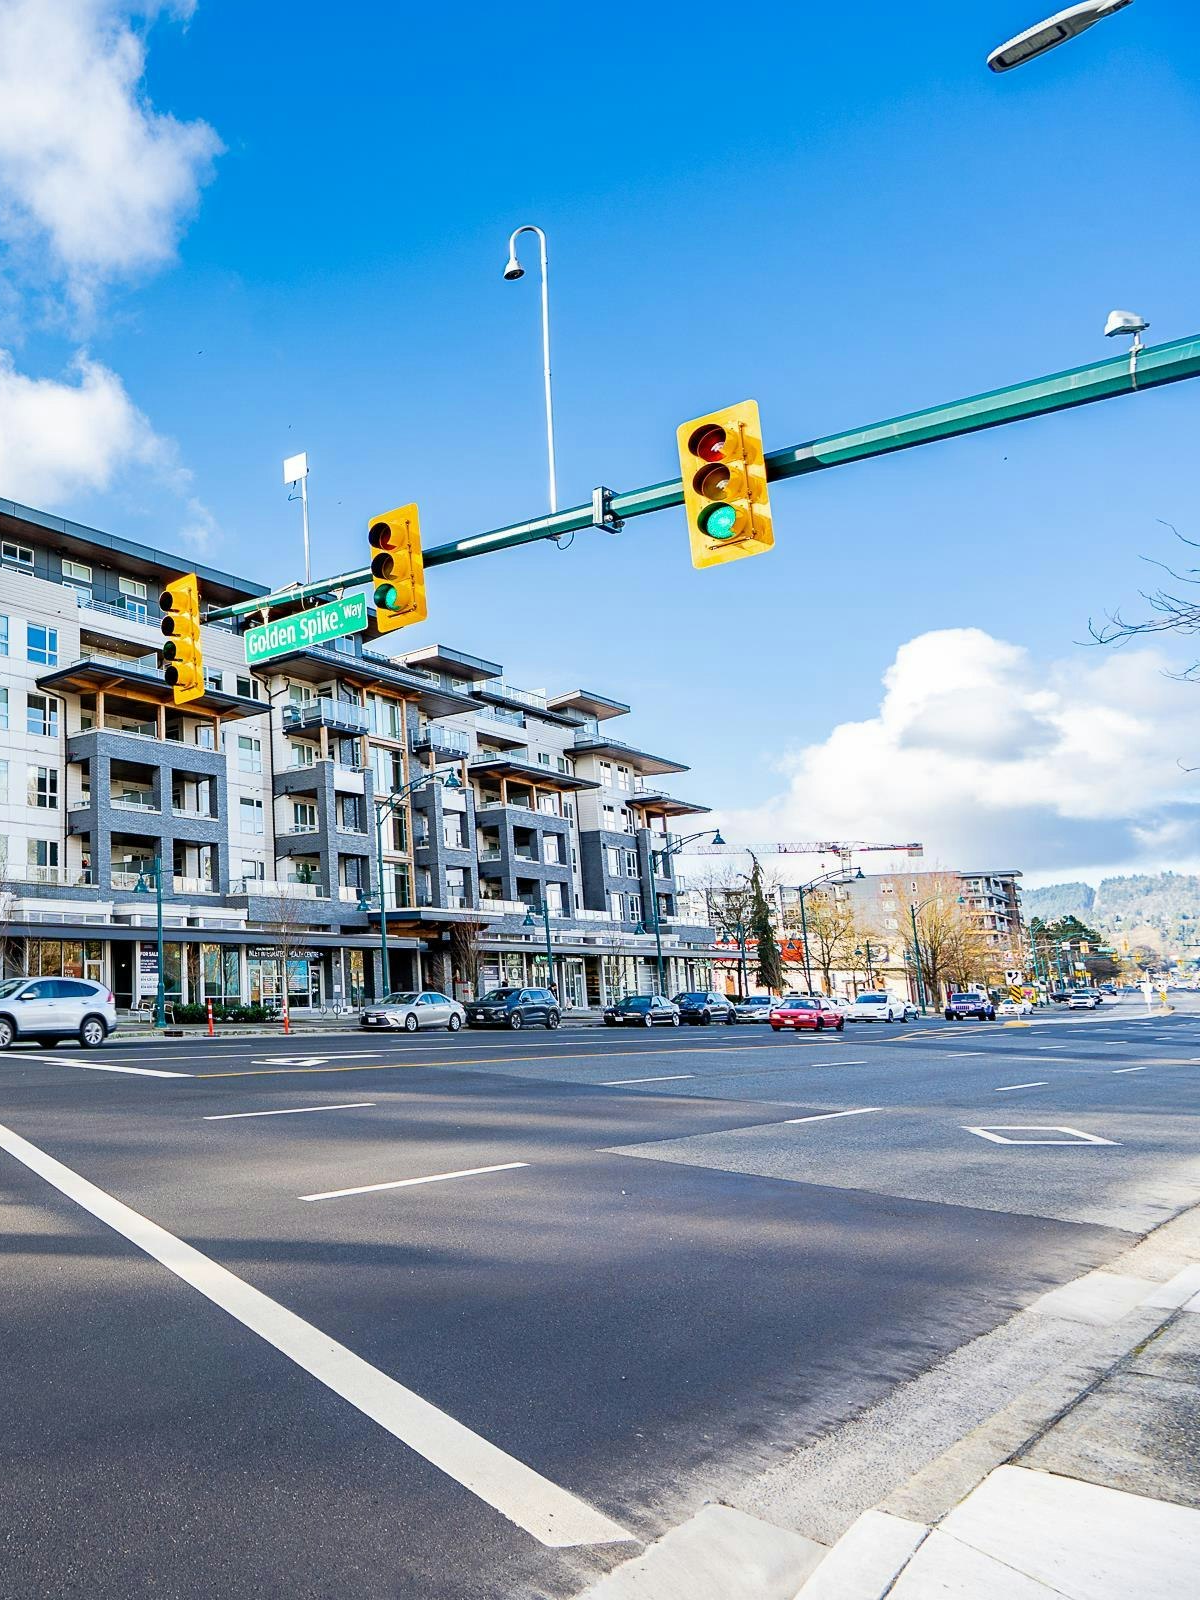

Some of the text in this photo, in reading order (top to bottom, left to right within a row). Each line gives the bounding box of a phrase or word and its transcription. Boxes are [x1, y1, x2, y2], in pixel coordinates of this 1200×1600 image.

[249, 603, 362, 655] Golden Spike Way
